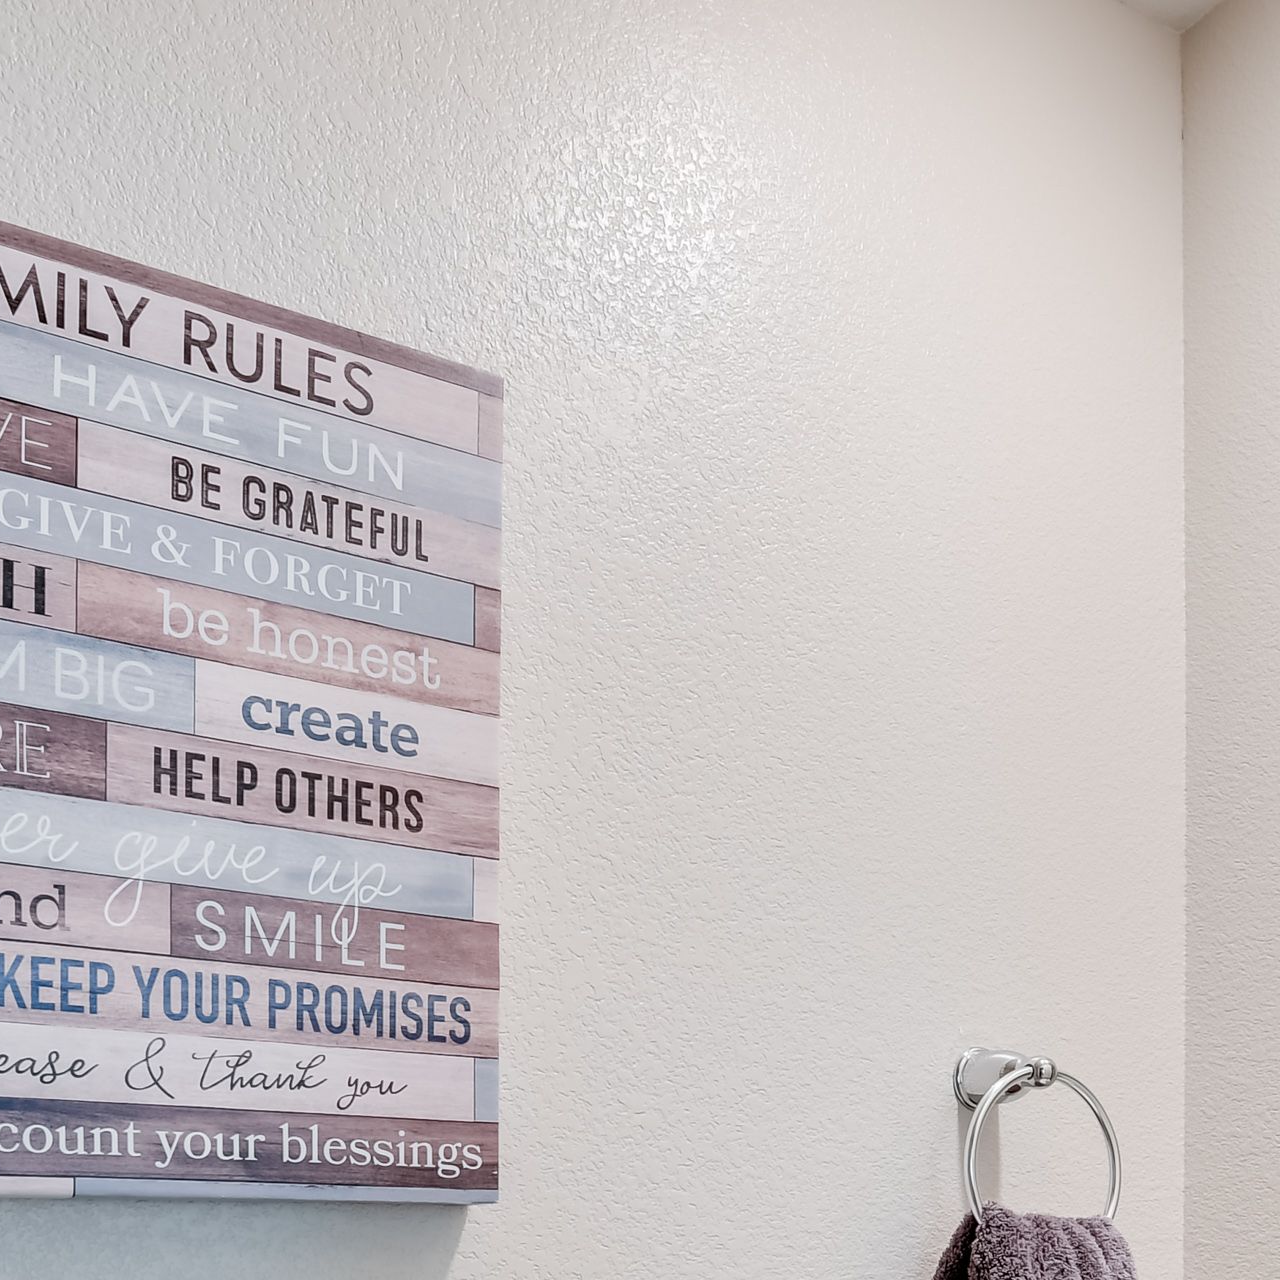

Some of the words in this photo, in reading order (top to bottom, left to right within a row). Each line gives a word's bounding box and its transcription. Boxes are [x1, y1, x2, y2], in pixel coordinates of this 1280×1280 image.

[182, 311, 376, 417] RULES
[52, 353, 241, 445] HAVE
[277, 418, 407, 492] FUN
[170, 455, 221, 511] BE
[242, 473, 430, 563] GRATEFUL
[150, 523, 193, 568] &
[210, 535, 413, 617] FORGET
[53, 644, 158, 712] BIG
[157, 586, 231, 648] be
[248, 606, 443, 690] honest
[240, 692, 422, 758] create
[152, 746, 258, 808] HELP
[274, 767, 426, 834] OTHERS
[103, 820, 281, 927] give
[306, 852, 403, 947] up
[193, 899, 408, 971] SMILE
[132, 965, 252, 1029] YOUR
[267, 979, 474, 1046] PROMISES
[122, 1036, 176, 1100] &
[194, 1048, 329, 1091] thank
[343, 1074, 409, 1110] you
[154, 1125, 266, 1168] your
[277, 1123, 484, 1179] blessings
